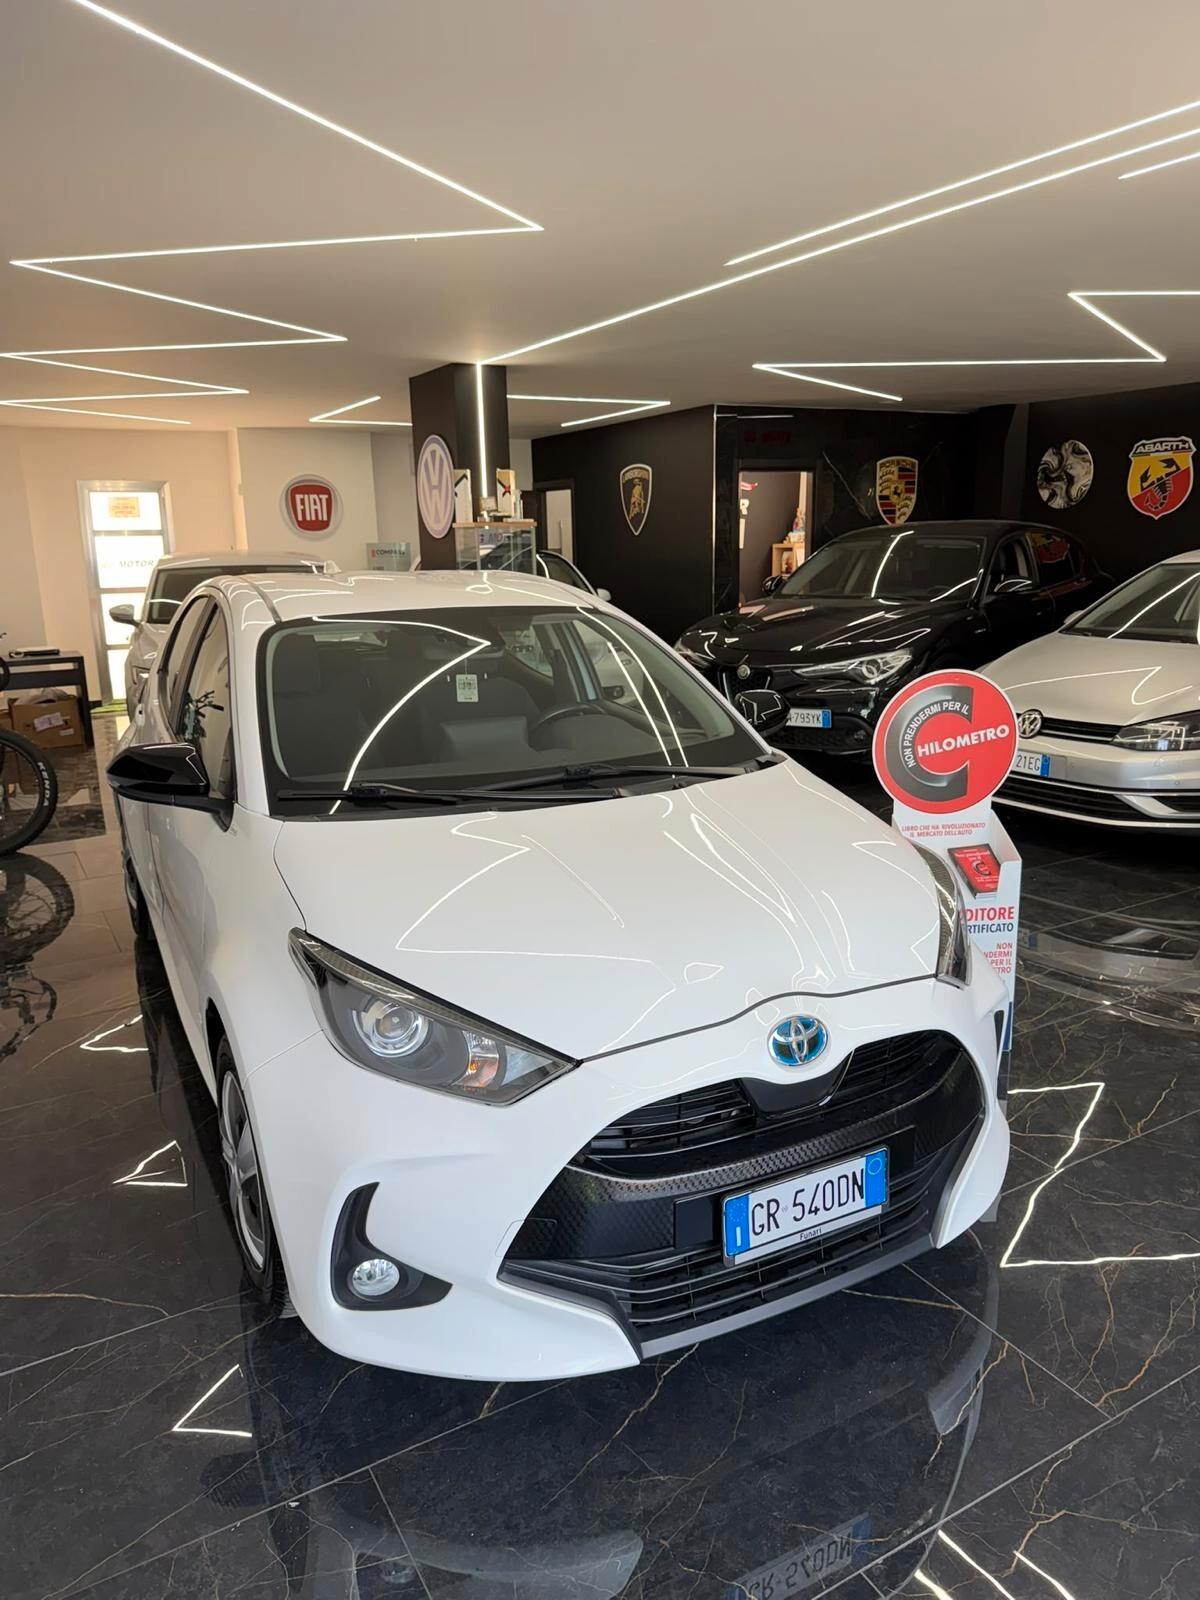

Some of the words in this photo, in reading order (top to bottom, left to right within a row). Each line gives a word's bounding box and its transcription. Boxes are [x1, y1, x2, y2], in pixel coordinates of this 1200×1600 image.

[1135, 441, 1189, 453] ABARTH
[295, 493, 328, 521] FIAT
[942, 701, 961, 712] PER
[961, 704, 970, 716] IL
[903, 703, 941, 746] PRENDERMI
[917, 724, 1010, 757] HILOMETRO
[903, 748, 917, 768] NON
[37, 761, 51, 807] KENDA
[965, 906, 1015, 922] DITORE
[994, 966, 1012, 974] TRO
[751, 1198, 780, 1236] GR
[792, 1168, 865, 1223] 540DN
[800, 1228, 822, 1241] Funari
